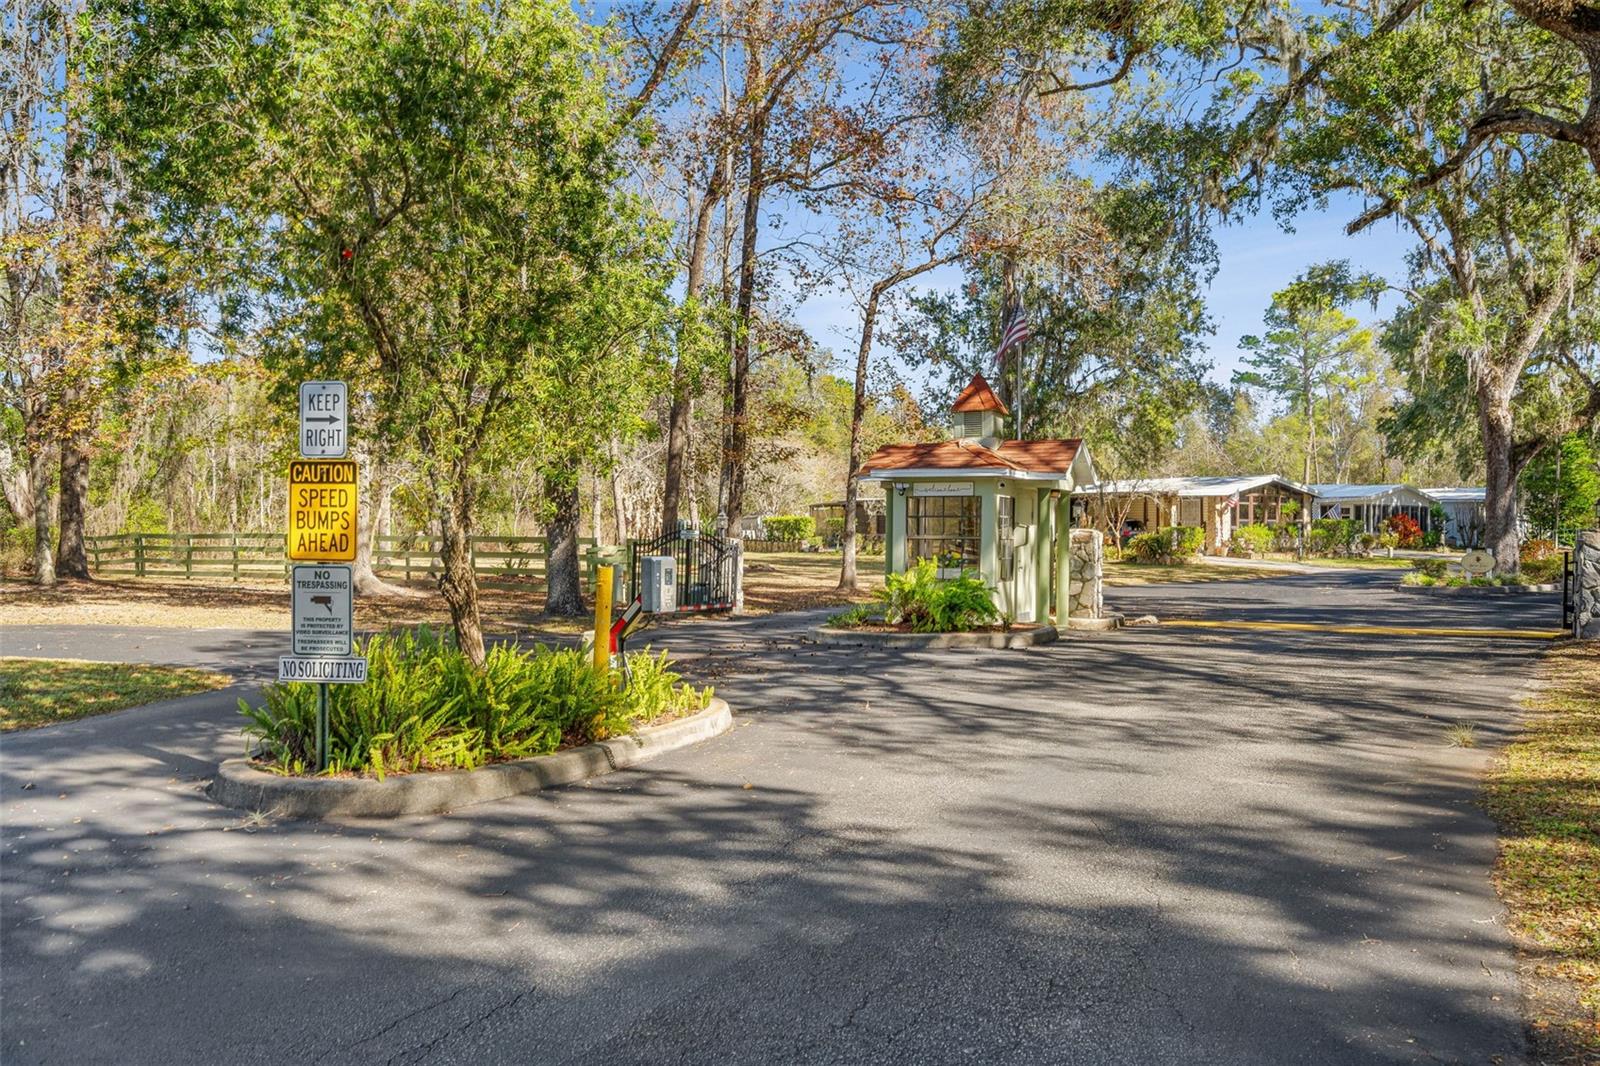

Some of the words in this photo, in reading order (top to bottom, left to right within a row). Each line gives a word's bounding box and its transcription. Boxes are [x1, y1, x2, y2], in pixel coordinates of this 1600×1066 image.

[308, 393, 340, 411] KEEP
[306, 429, 342, 447] RIGHT
[293, 464, 353, 482] CAUTION
[298, 488, 348, 508] SPEED
[296, 510, 350, 530] BUMPS
[297, 533, 349, 553] AHEAD
[314, 570, 330, 580] NO
[297, 580, 348, 590] TRESPASSING
[282, 660, 297, 678] NO
[298, 661, 363, 679] SOLICITING
